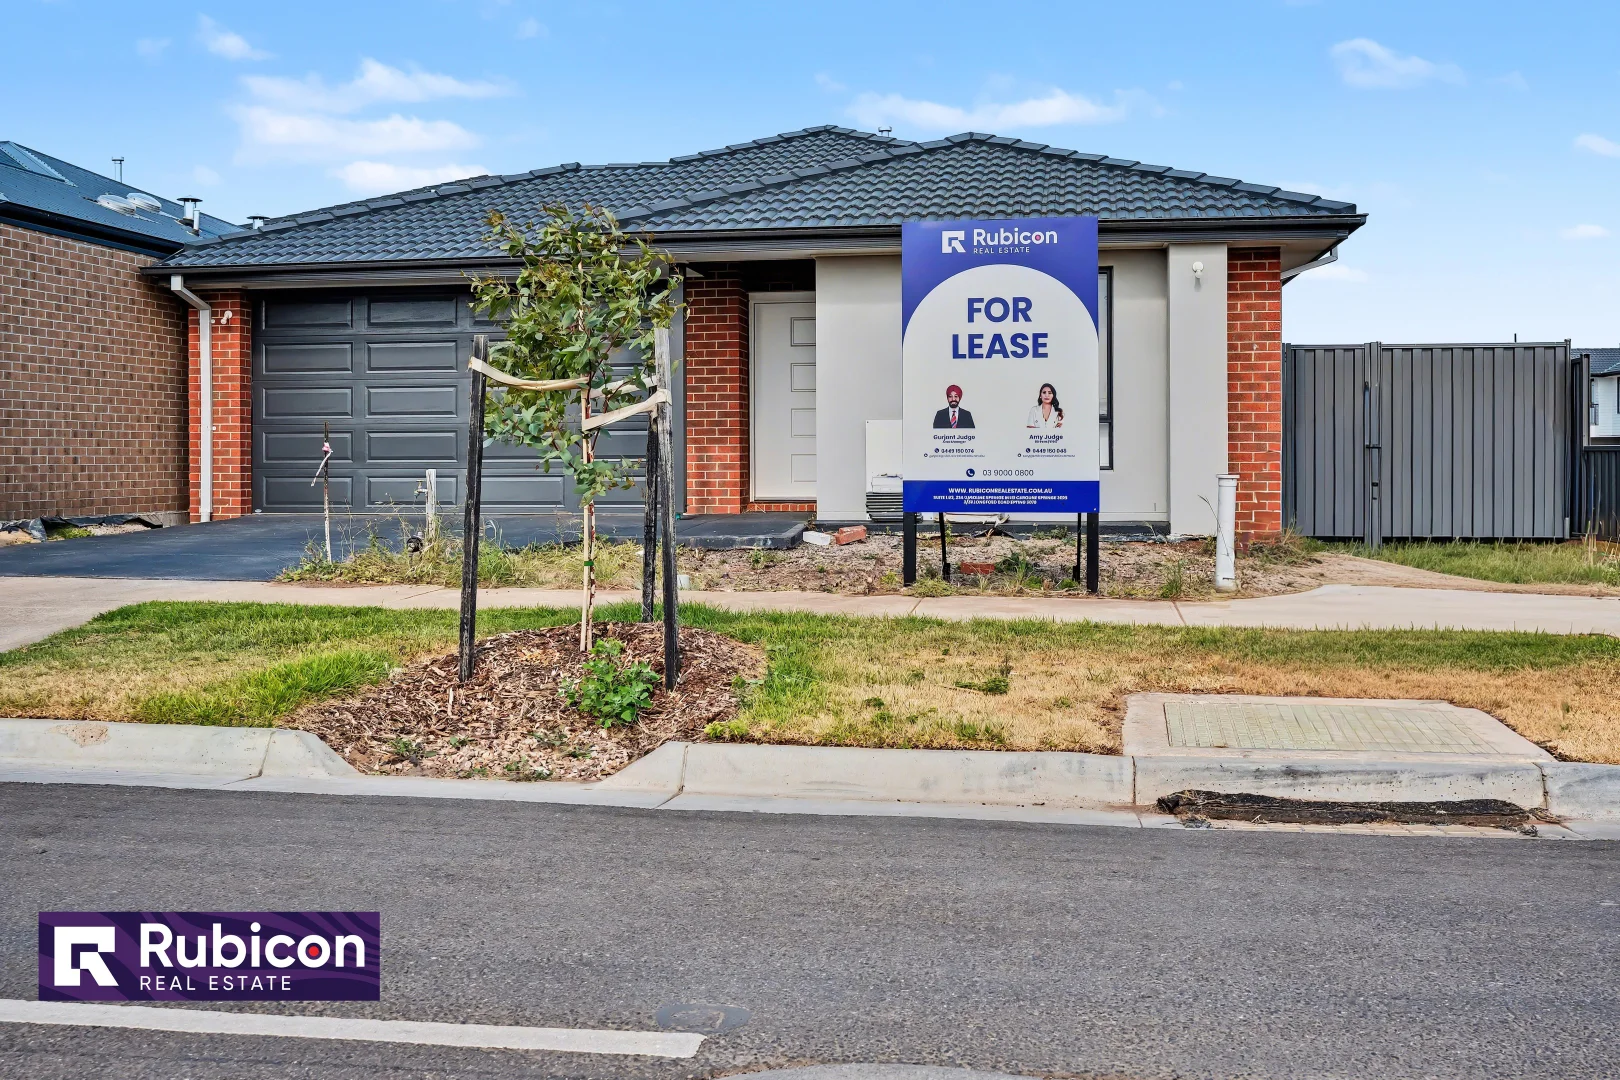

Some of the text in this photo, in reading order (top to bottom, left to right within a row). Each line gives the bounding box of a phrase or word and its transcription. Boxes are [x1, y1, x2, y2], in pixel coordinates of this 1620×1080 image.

[973, 228, 1058, 246] Rubicon
[967, 297, 1033, 323] FOR
[952, 332, 1048, 359] LEASE
[982, 469, 1034, 477] 03 9000 0800
